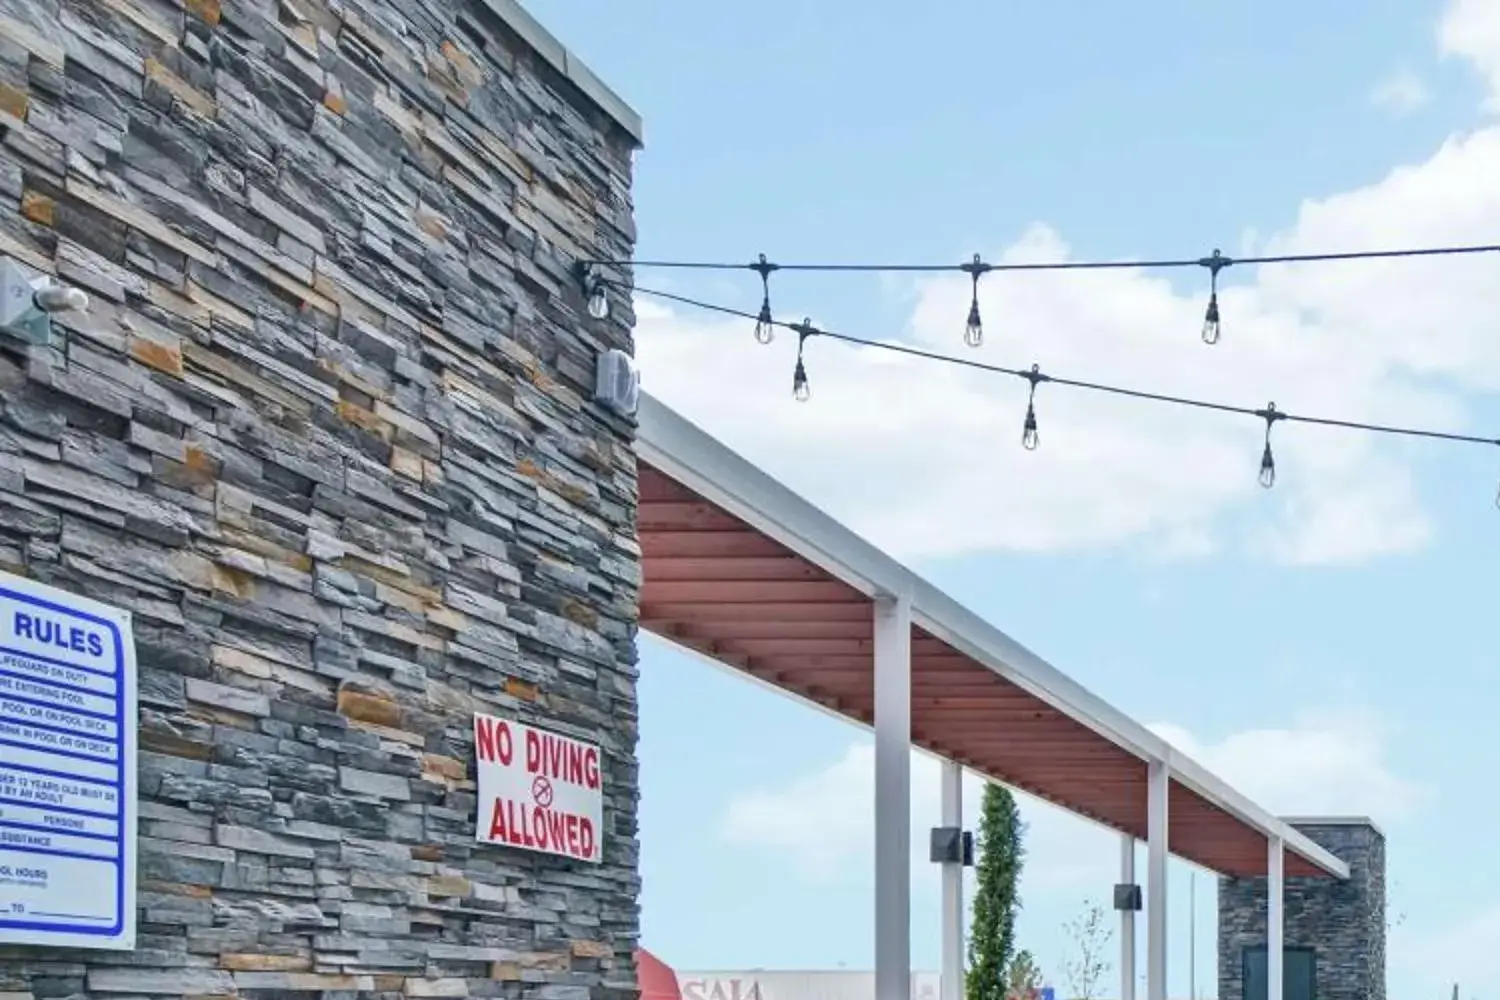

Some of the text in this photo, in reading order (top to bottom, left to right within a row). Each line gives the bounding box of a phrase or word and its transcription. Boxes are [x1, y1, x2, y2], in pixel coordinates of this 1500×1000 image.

[14, 611, 104, 657] RULES
[66, 671, 88, 684] DUTY
[62, 692, 86, 705] POOL
[29, 707, 43, 719] OR
[34, 731, 58, 744] POOL
[477, 718, 600, 790] NO DIVING
[30, 779, 60, 792] YEARS
[489, 797, 594, 858] ALLOWED
[15, 867, 48, 880] HOURS
[11, 903, 25, 913] TO
